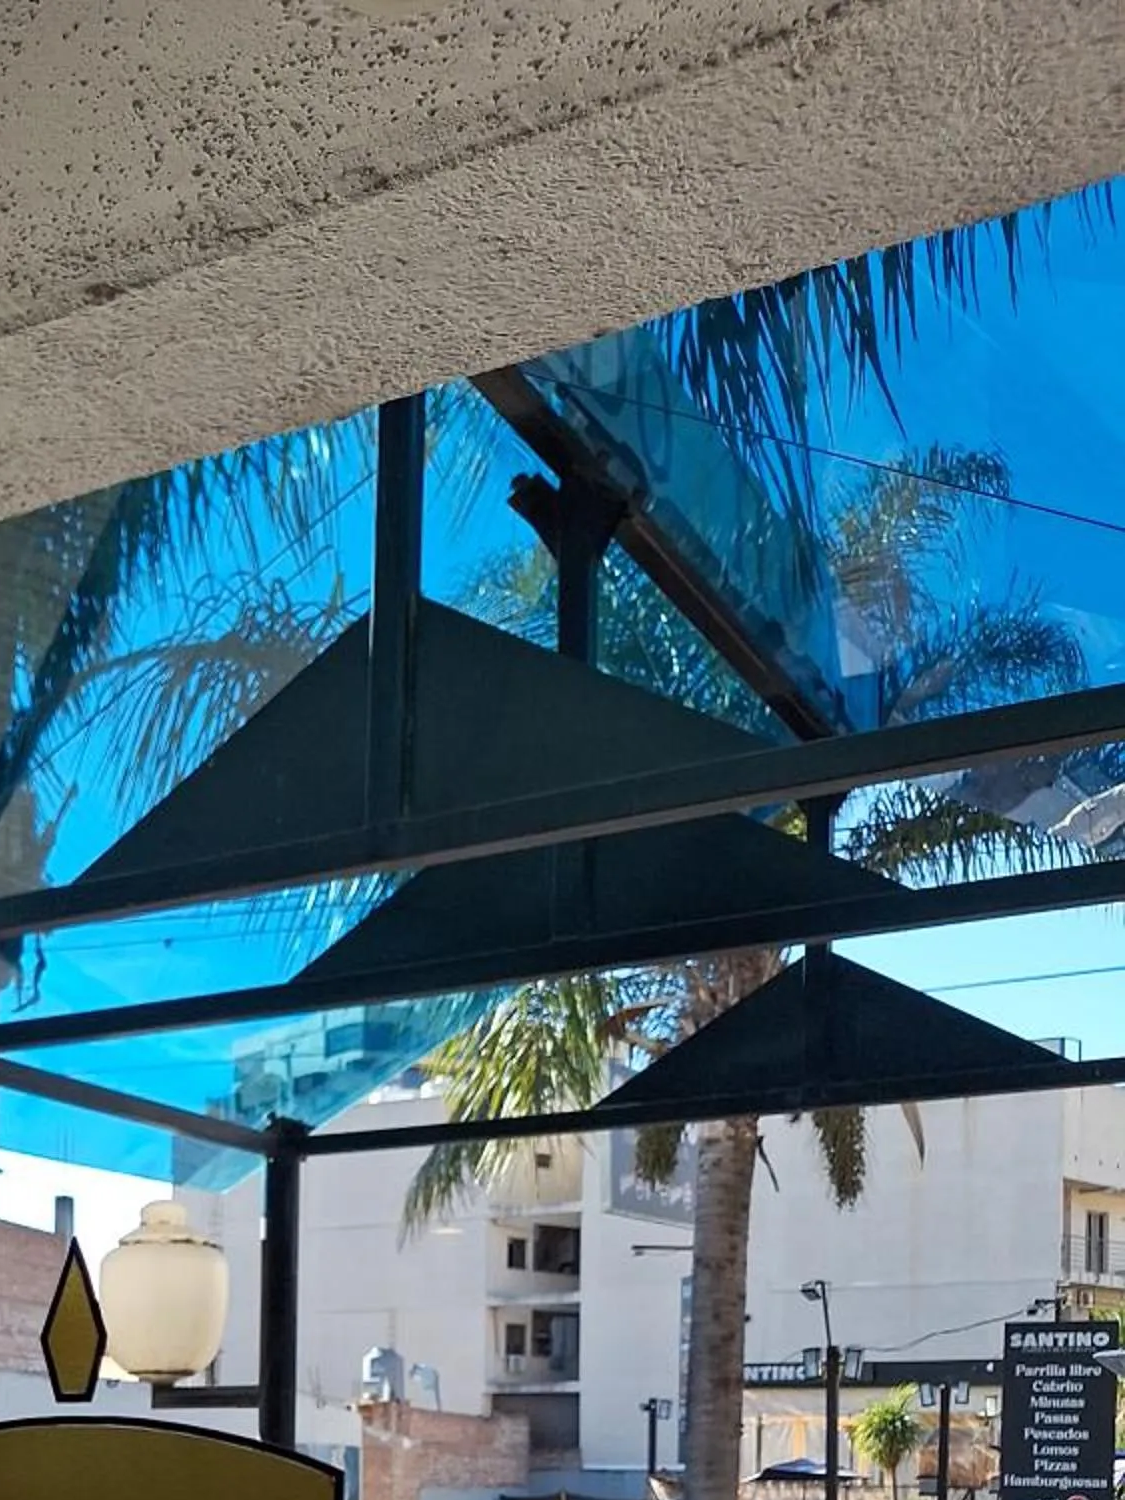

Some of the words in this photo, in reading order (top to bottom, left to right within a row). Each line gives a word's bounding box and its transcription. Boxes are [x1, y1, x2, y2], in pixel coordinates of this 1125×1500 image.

[1009, 1331, 1110, 1348] SANTINO
[1015, 1363, 1066, 1377] Parrilla
[1069, 1363, 1102, 1377] libre
[1030, 1396, 1086, 1409] Minutas
[1034, 1411, 1080, 1425] Pastas
[1023, 1427, 1090, 1440] Pescados
[1032, 1443, 1080, 1456] Lomos
[1034, 1459, 1078, 1471] Pizzas
[1003, 1474, 1108, 1490] Hamburguesas
